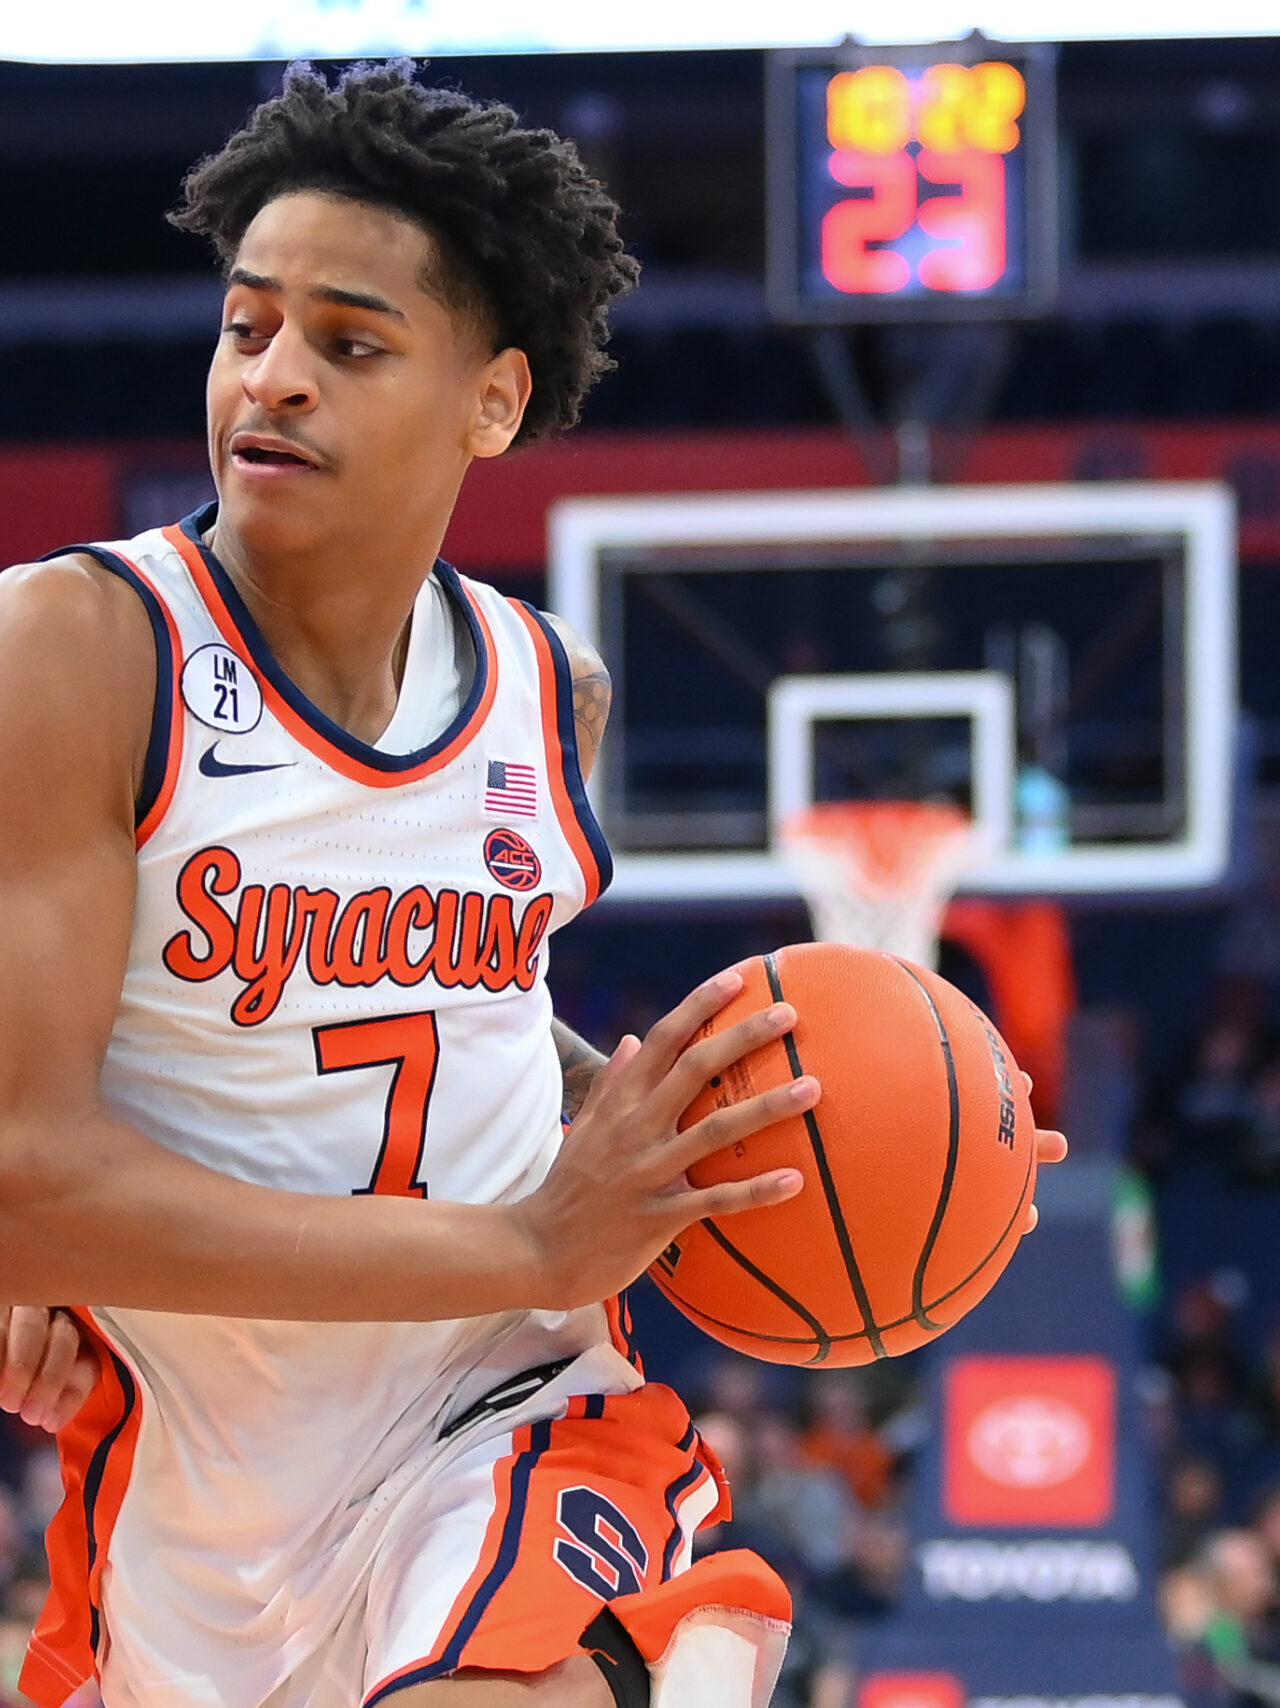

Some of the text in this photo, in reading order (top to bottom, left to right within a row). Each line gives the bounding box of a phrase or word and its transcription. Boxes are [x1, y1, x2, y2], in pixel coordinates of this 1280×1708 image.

[822, 148, 1006, 293] 23
[214, 654, 237, 685] LM
[214, 683, 238, 723] 21
[494, 849, 534, 866] ACC
[162, 846, 554, 1026] Syracuse
[311, 1010, 440, 1200] 7
